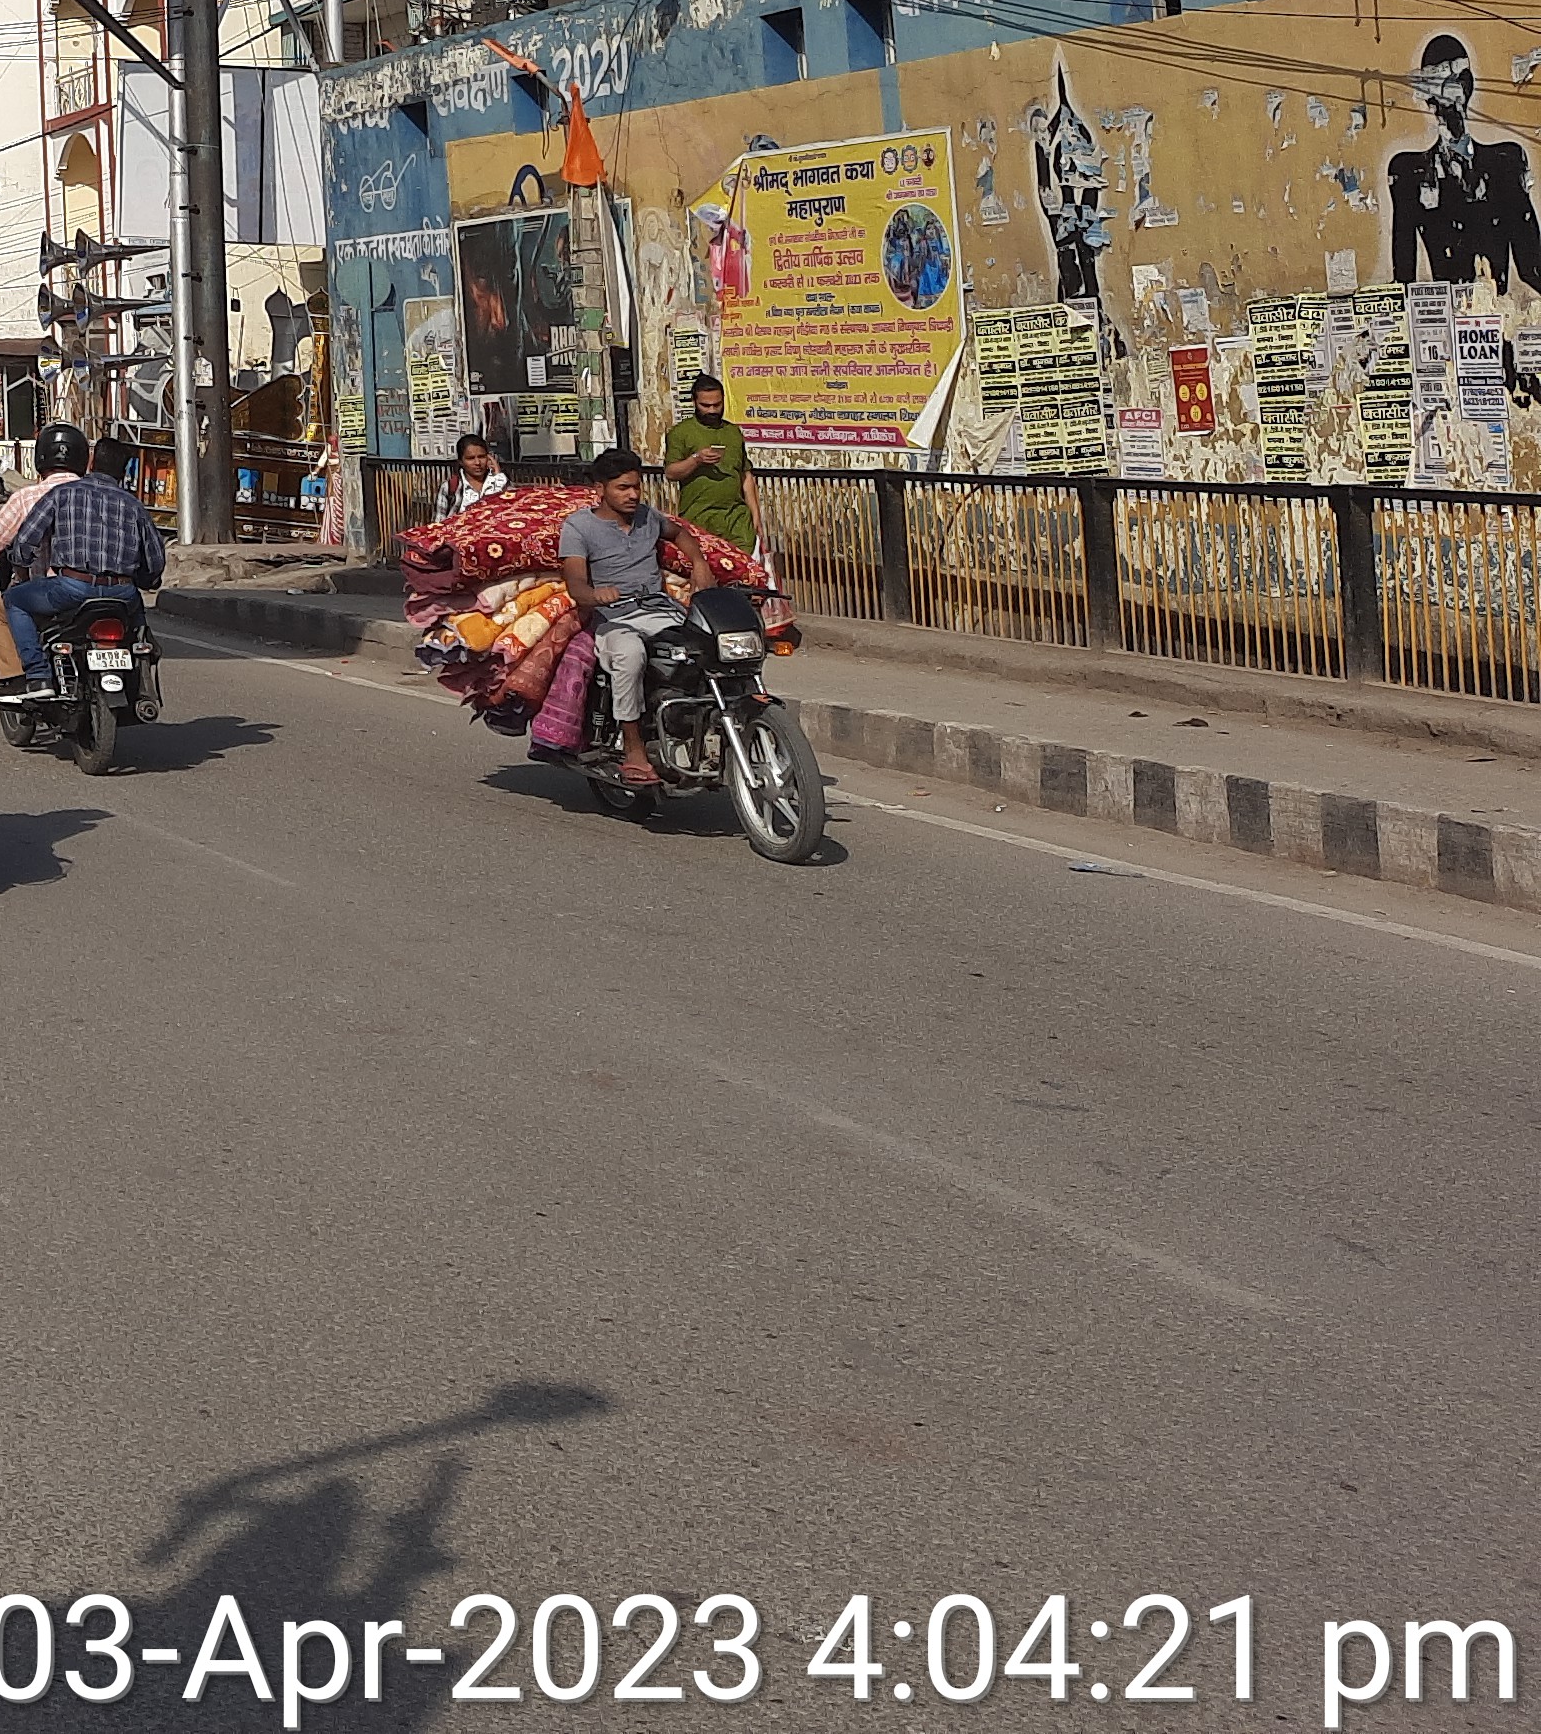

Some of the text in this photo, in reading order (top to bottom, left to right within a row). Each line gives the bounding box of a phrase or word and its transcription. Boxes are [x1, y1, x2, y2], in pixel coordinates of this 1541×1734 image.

[552, 37, 629, 103] 2020
[753, 160, 875, 197] श्रीमद् भागवत कथा
[786, 196, 847, 227] महापुराण
[1458, 329, 1500, 344] HOME
[1459, 345, 1500, 361] LOAN
